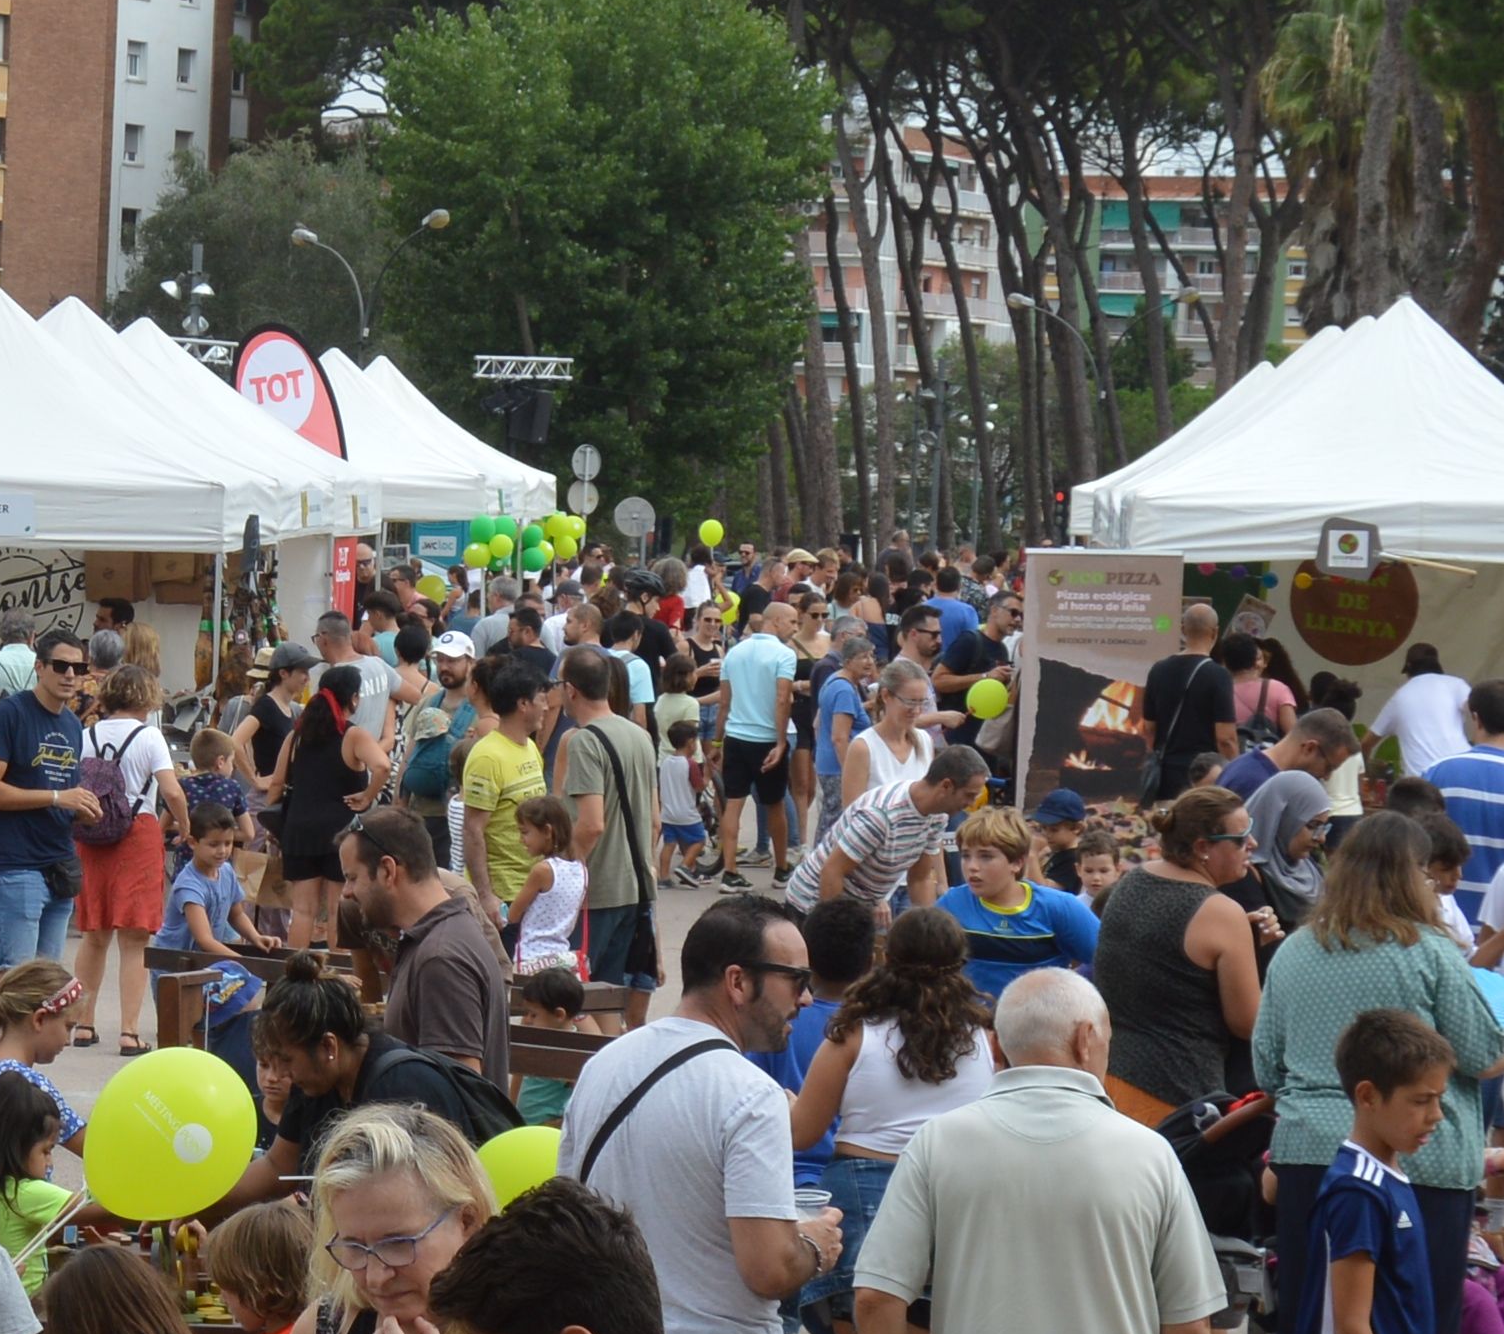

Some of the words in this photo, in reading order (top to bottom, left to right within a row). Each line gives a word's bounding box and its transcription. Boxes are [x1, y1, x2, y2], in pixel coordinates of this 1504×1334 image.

[249, 369, 304, 405] TOT
[1056, 590, 1091, 600] Pizzas
[1338, 592, 1369, 610] DE
[1070, 602, 1103, 611] horno
[1105, 602, 1119, 611] de
[1304, 612, 1397, 640] LLENYA
